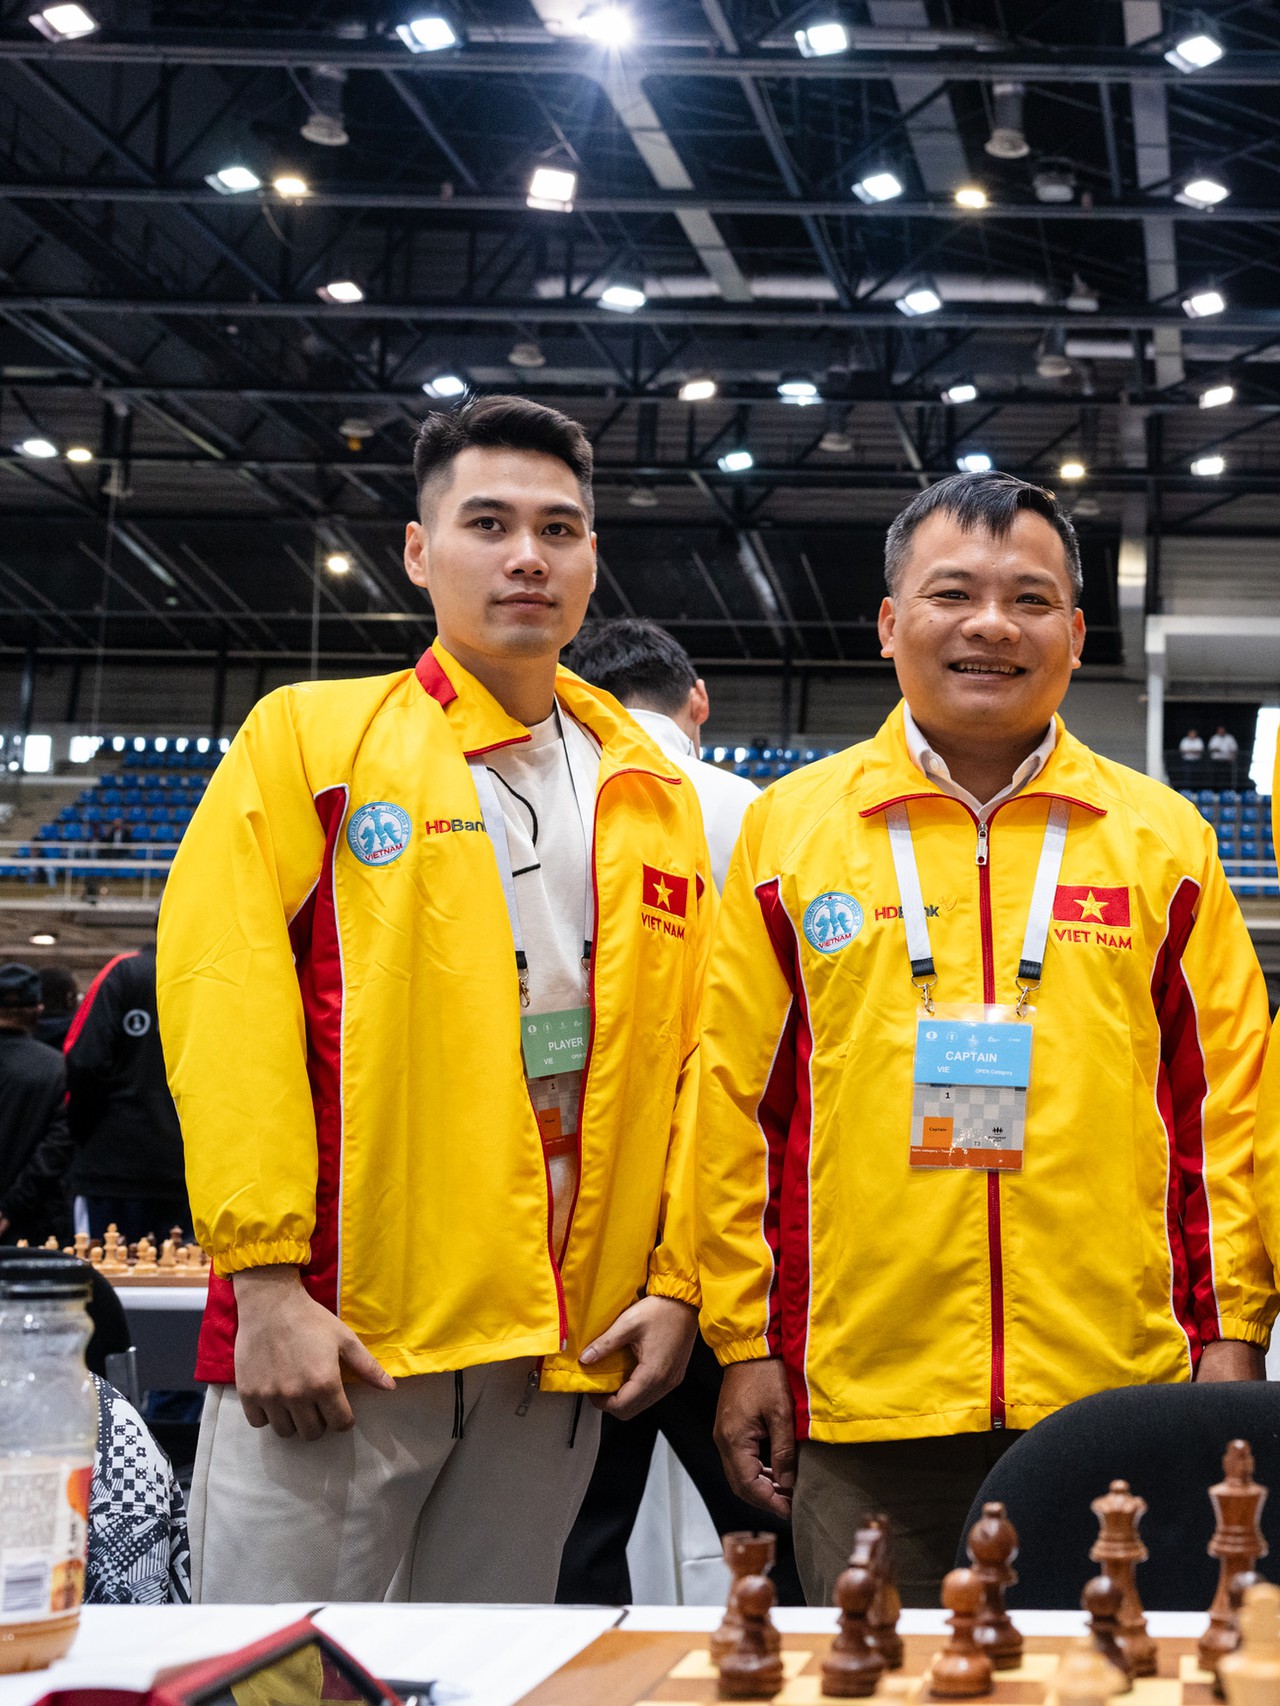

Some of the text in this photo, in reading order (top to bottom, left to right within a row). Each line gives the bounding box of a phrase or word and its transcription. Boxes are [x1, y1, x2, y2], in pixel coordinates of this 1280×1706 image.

[426, 818, 486, 835] HDBan
[364, 843, 403, 861] VIETNAM
[641, 912, 685, 940] VIET NAM
[818, 932, 852, 948] VIETNAM
[1054, 928, 1132, 950] VIET NAM
[548, 1037, 584, 1051] PLAYER
[946, 1051, 998, 1062] CAPTAIN
